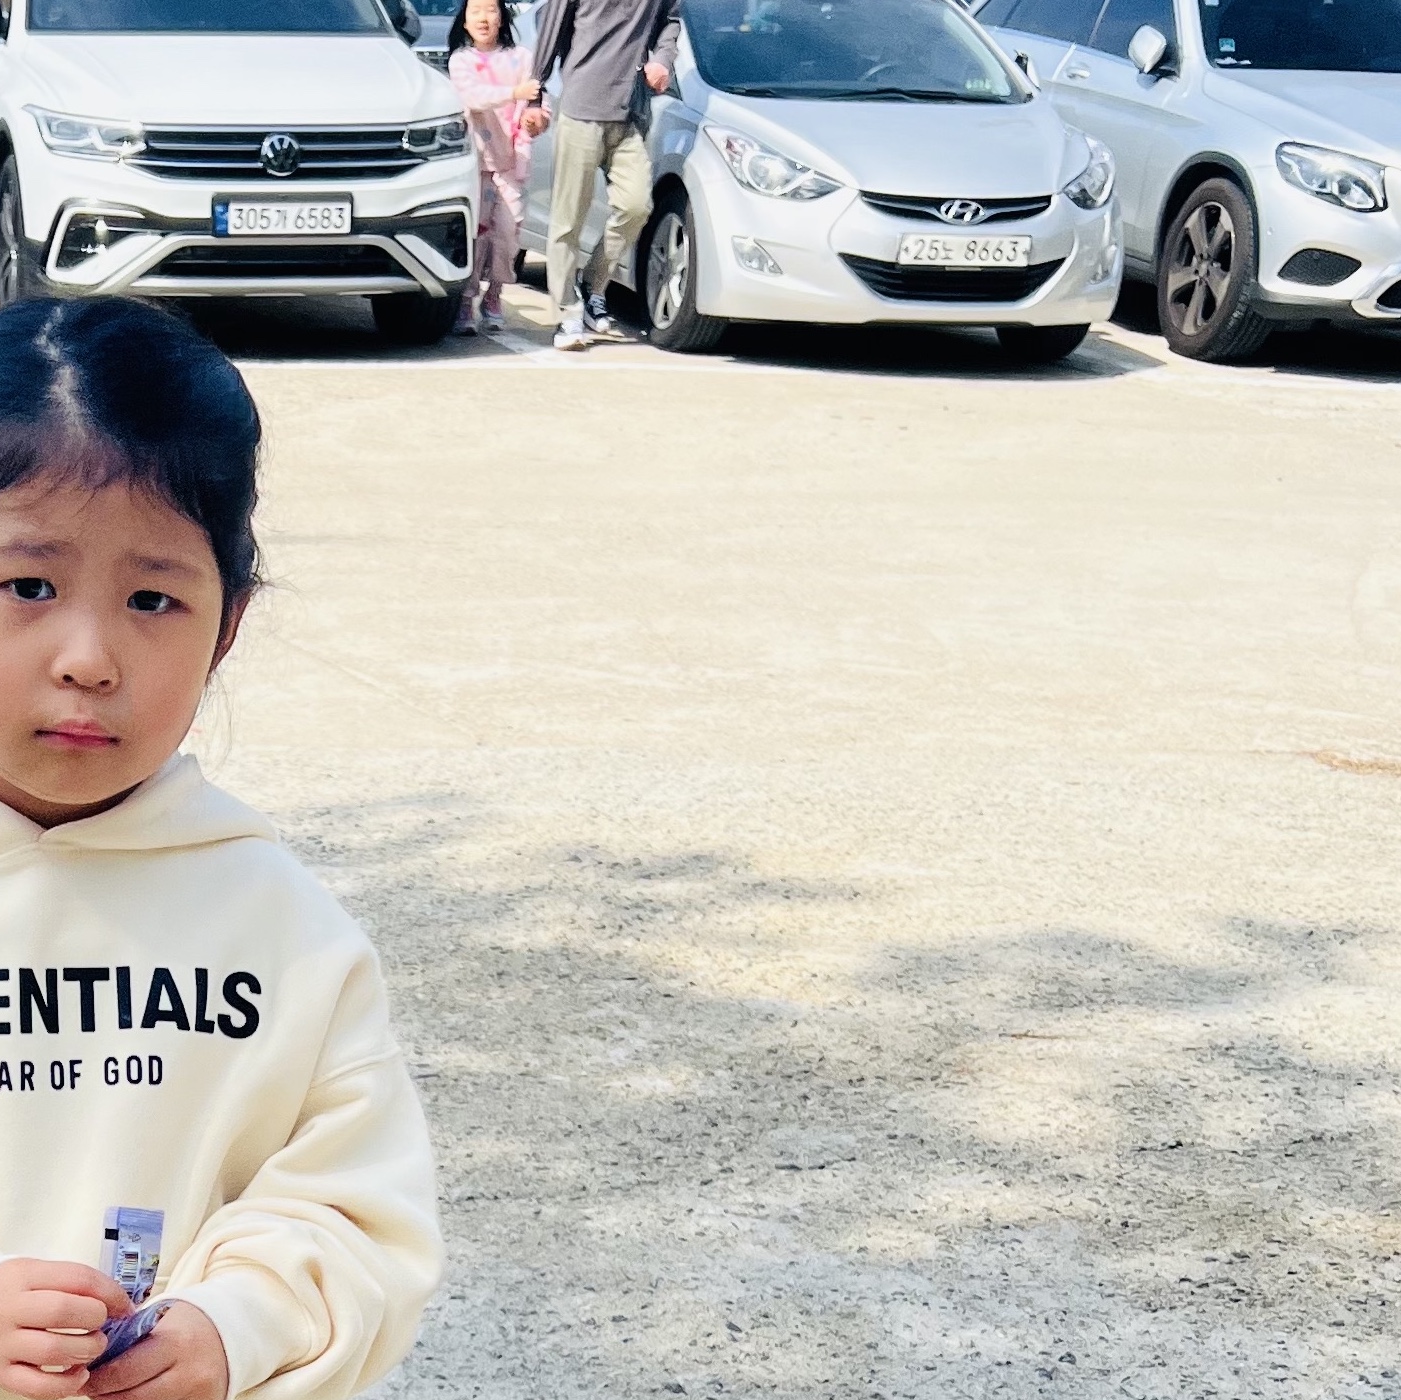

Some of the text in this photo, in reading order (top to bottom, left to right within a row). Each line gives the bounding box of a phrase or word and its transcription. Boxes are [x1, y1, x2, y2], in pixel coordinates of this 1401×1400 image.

[294, 207, 345, 229] 6583
[964, 239, 1019, 262] 8663
[49, 1059, 83, 1091] OF
[103, 1055, 164, 1086] GOD
